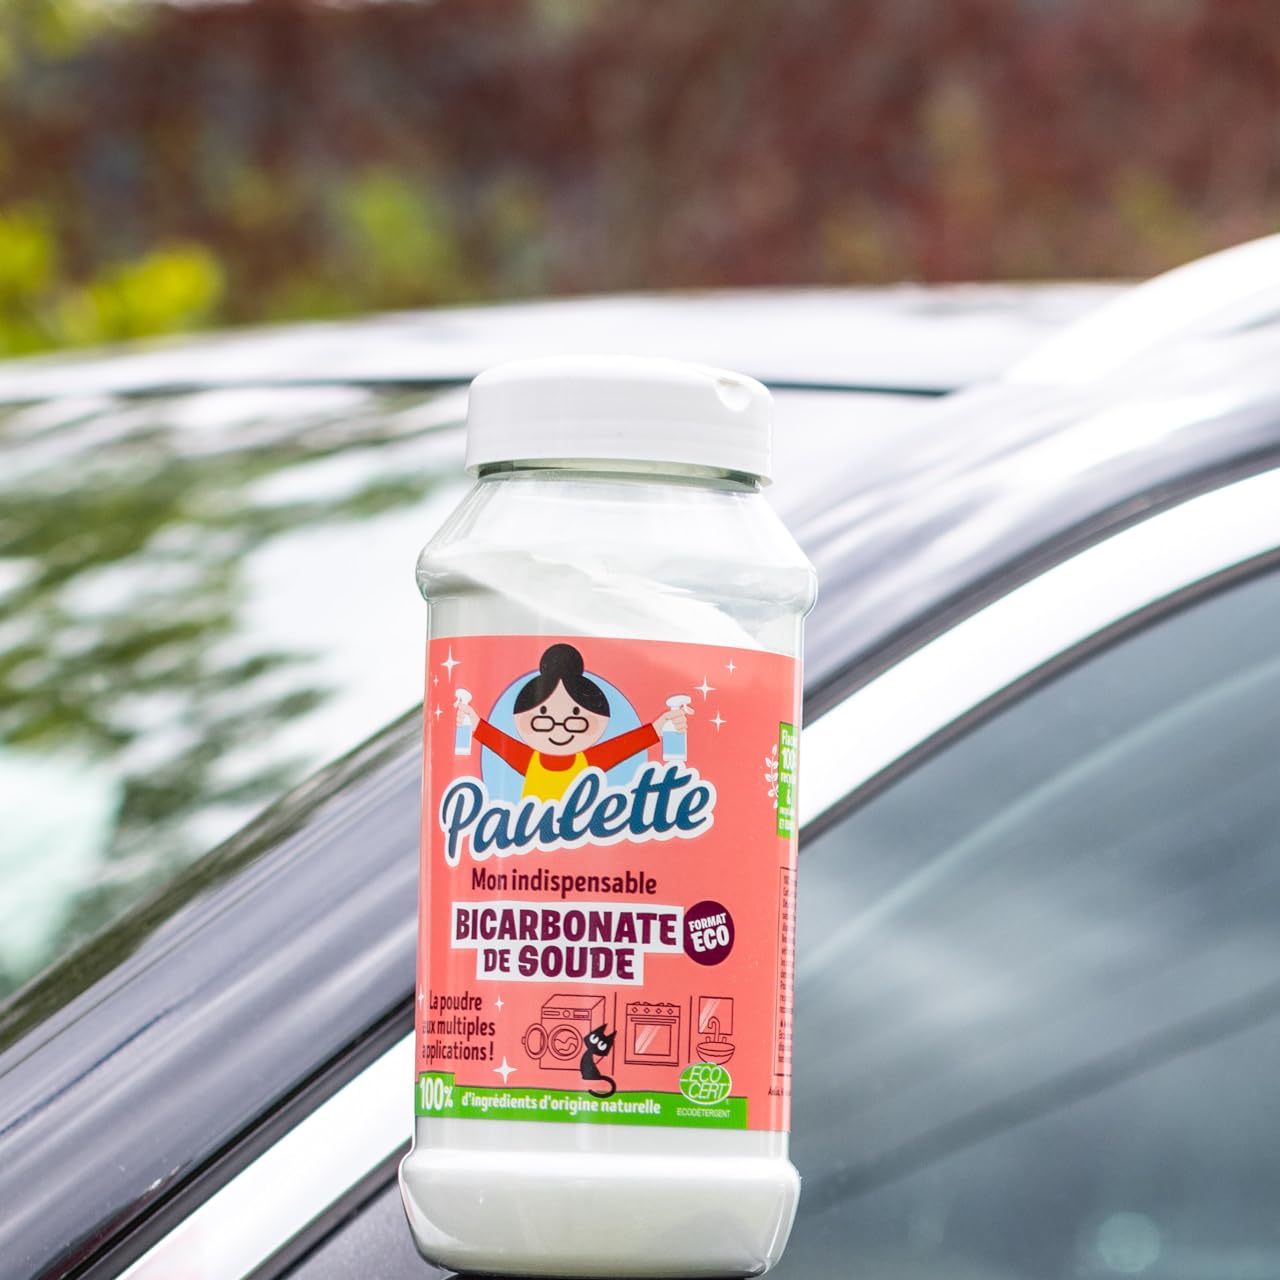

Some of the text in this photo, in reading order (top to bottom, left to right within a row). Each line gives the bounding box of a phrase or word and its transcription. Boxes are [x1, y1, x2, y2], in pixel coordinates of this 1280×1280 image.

[442, 765, 711, 859] Paulette
[471, 867, 657, 899] Mon indispensable
[455, 907, 677, 946] BICARBONATE
[688, 912, 727, 930] FORMAT
[690, 926, 730, 953] ECO
[483, 945, 635, 980] DE SOUDE
[429, 990, 482, 1016] La poudre
[437, 1016, 496, 1042] multiples
[688, 1065, 722, 1083] ECO
[420, 1077, 661, 1116] 100% d'ingrédients d'origine naturelle
[688, 1082, 727, 1100] CERT
